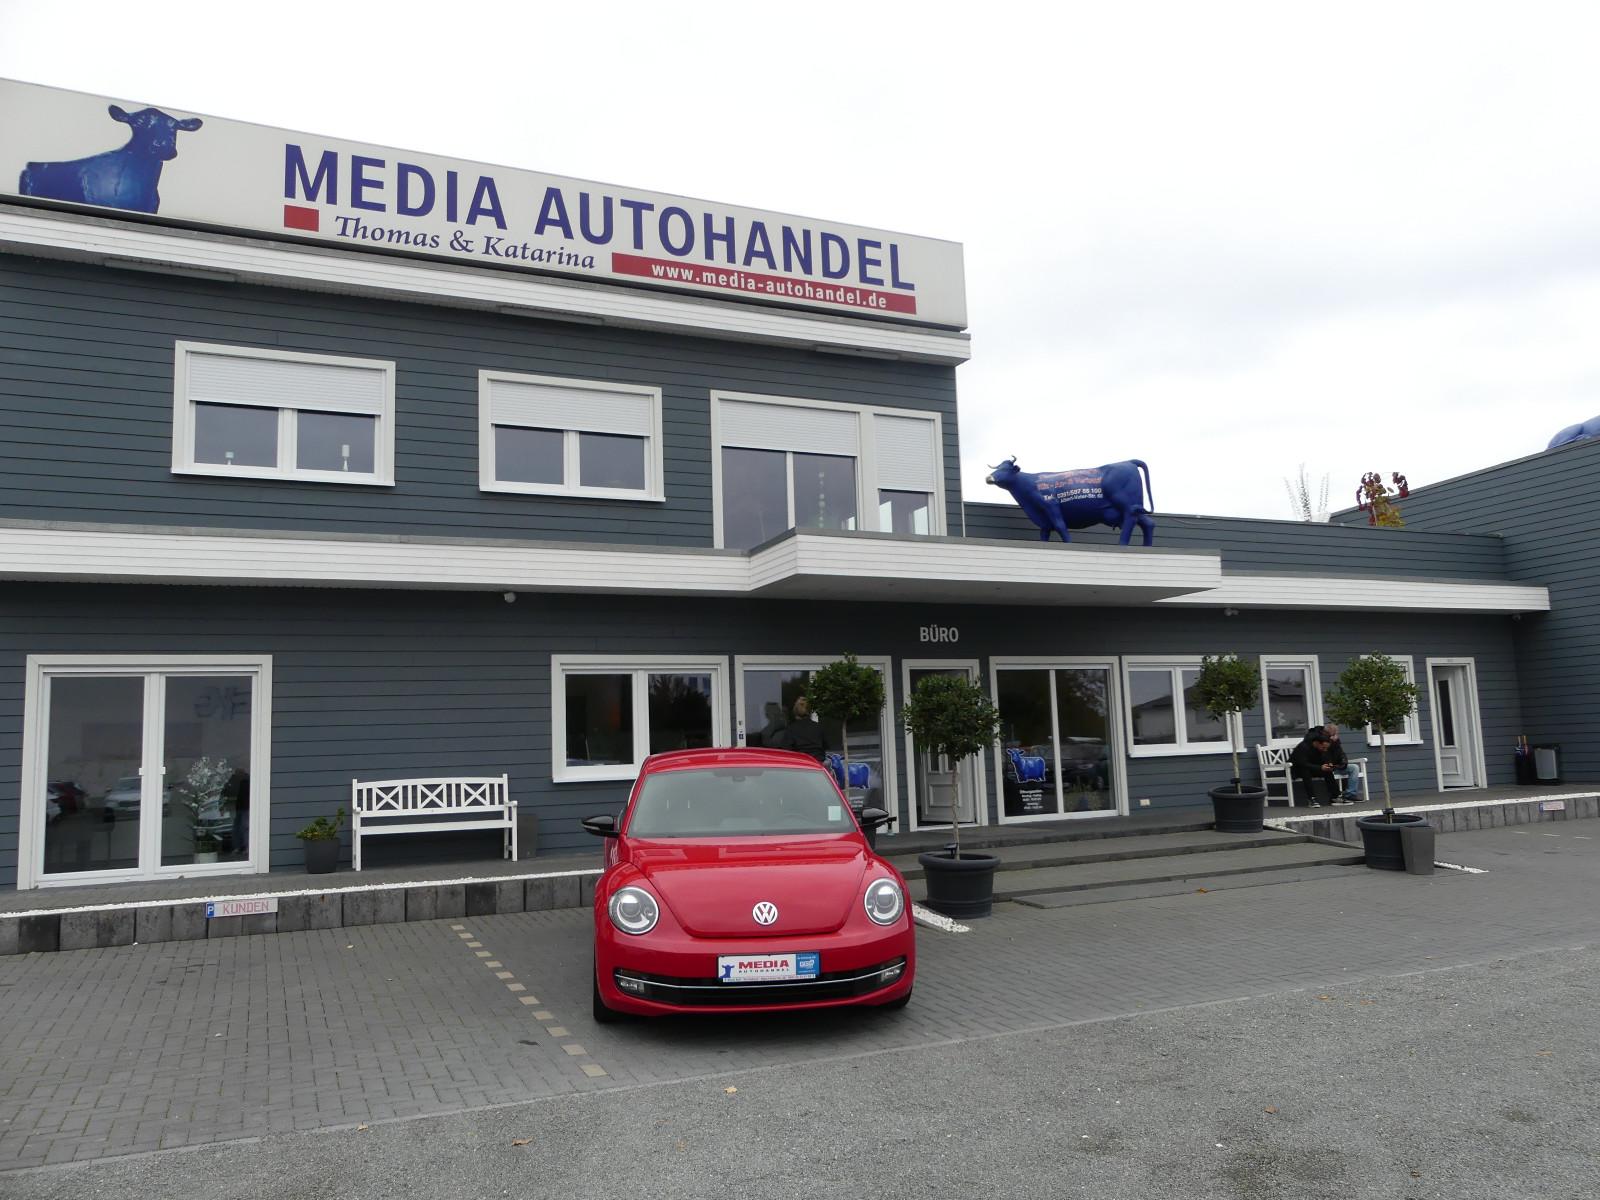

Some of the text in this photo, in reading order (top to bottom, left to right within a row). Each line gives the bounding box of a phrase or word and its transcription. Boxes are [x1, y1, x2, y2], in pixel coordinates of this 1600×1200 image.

[284, 143, 915, 291] MEDIA AUTOHANDEL
[335, 215, 596, 269] Thomas & Katarina
[652, 262, 887, 309] www.media-autohandel.de
[920, 624, 959, 642] BÜRO
[207, 901, 269, 915] P KUNDEN
[738, 960, 789, 969] MEDIA
